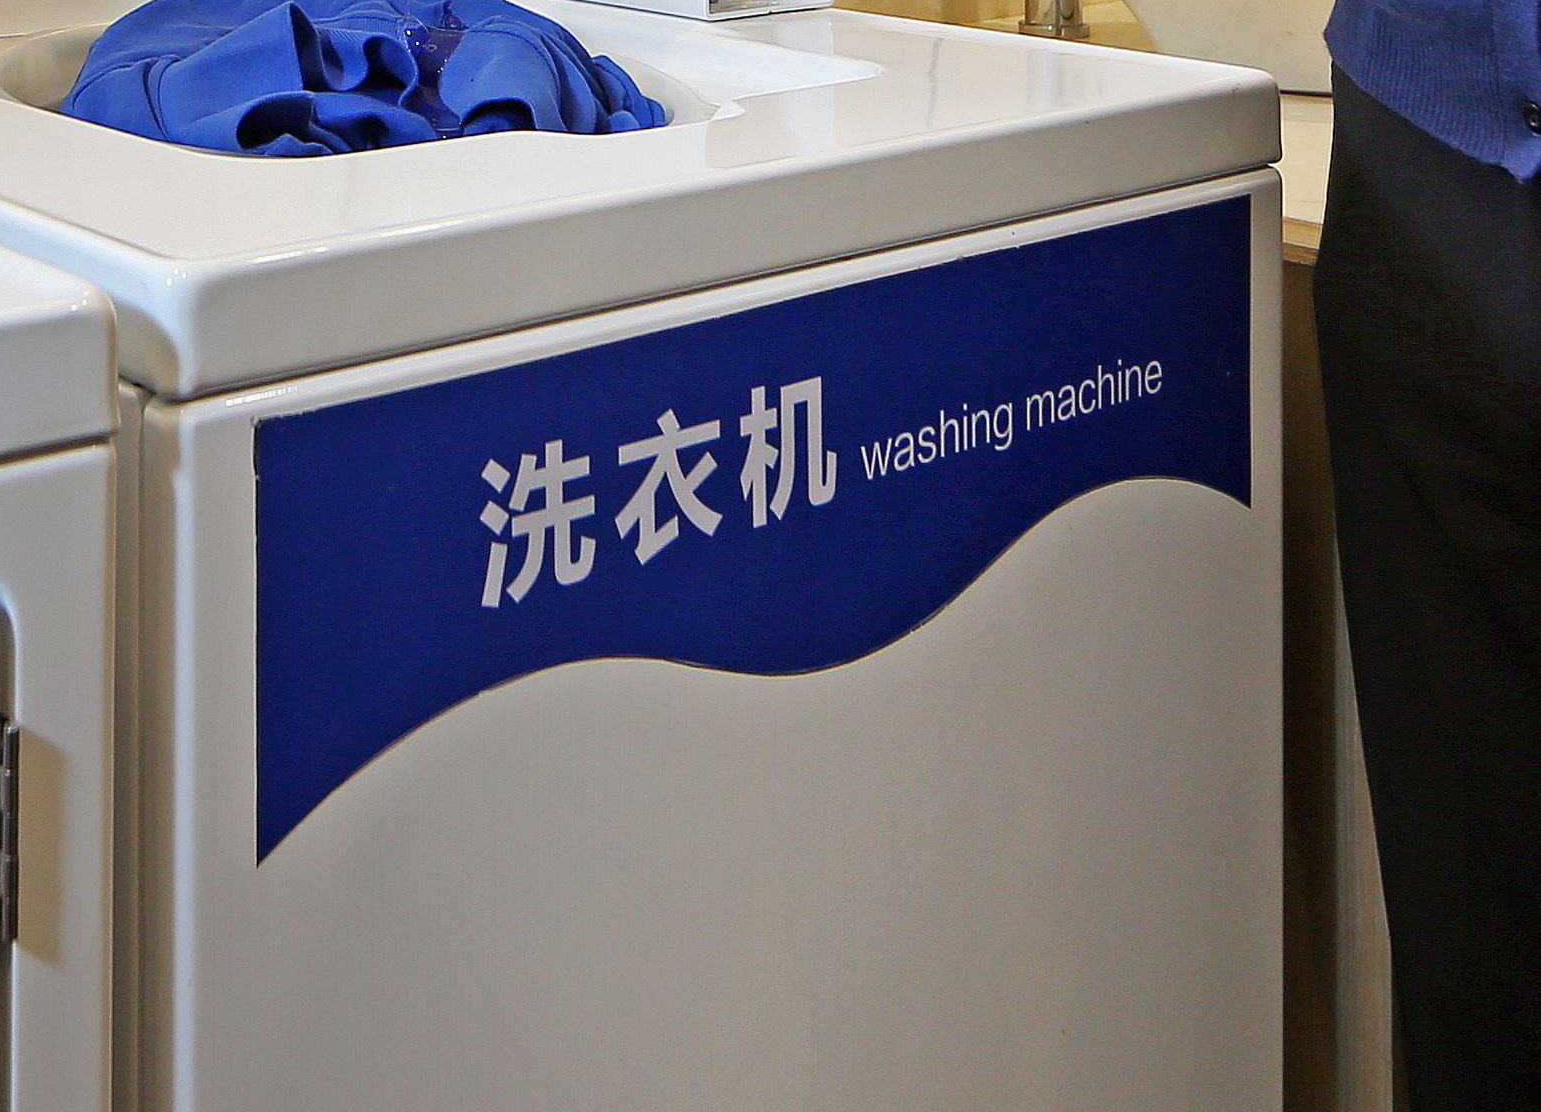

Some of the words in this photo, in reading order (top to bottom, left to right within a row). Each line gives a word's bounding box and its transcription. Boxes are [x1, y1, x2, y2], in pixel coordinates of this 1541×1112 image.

[480, 375, 837, 608] 洗衣机
[860, 403, 1013, 480] washing
[1026, 358, 1163, 431] machine
